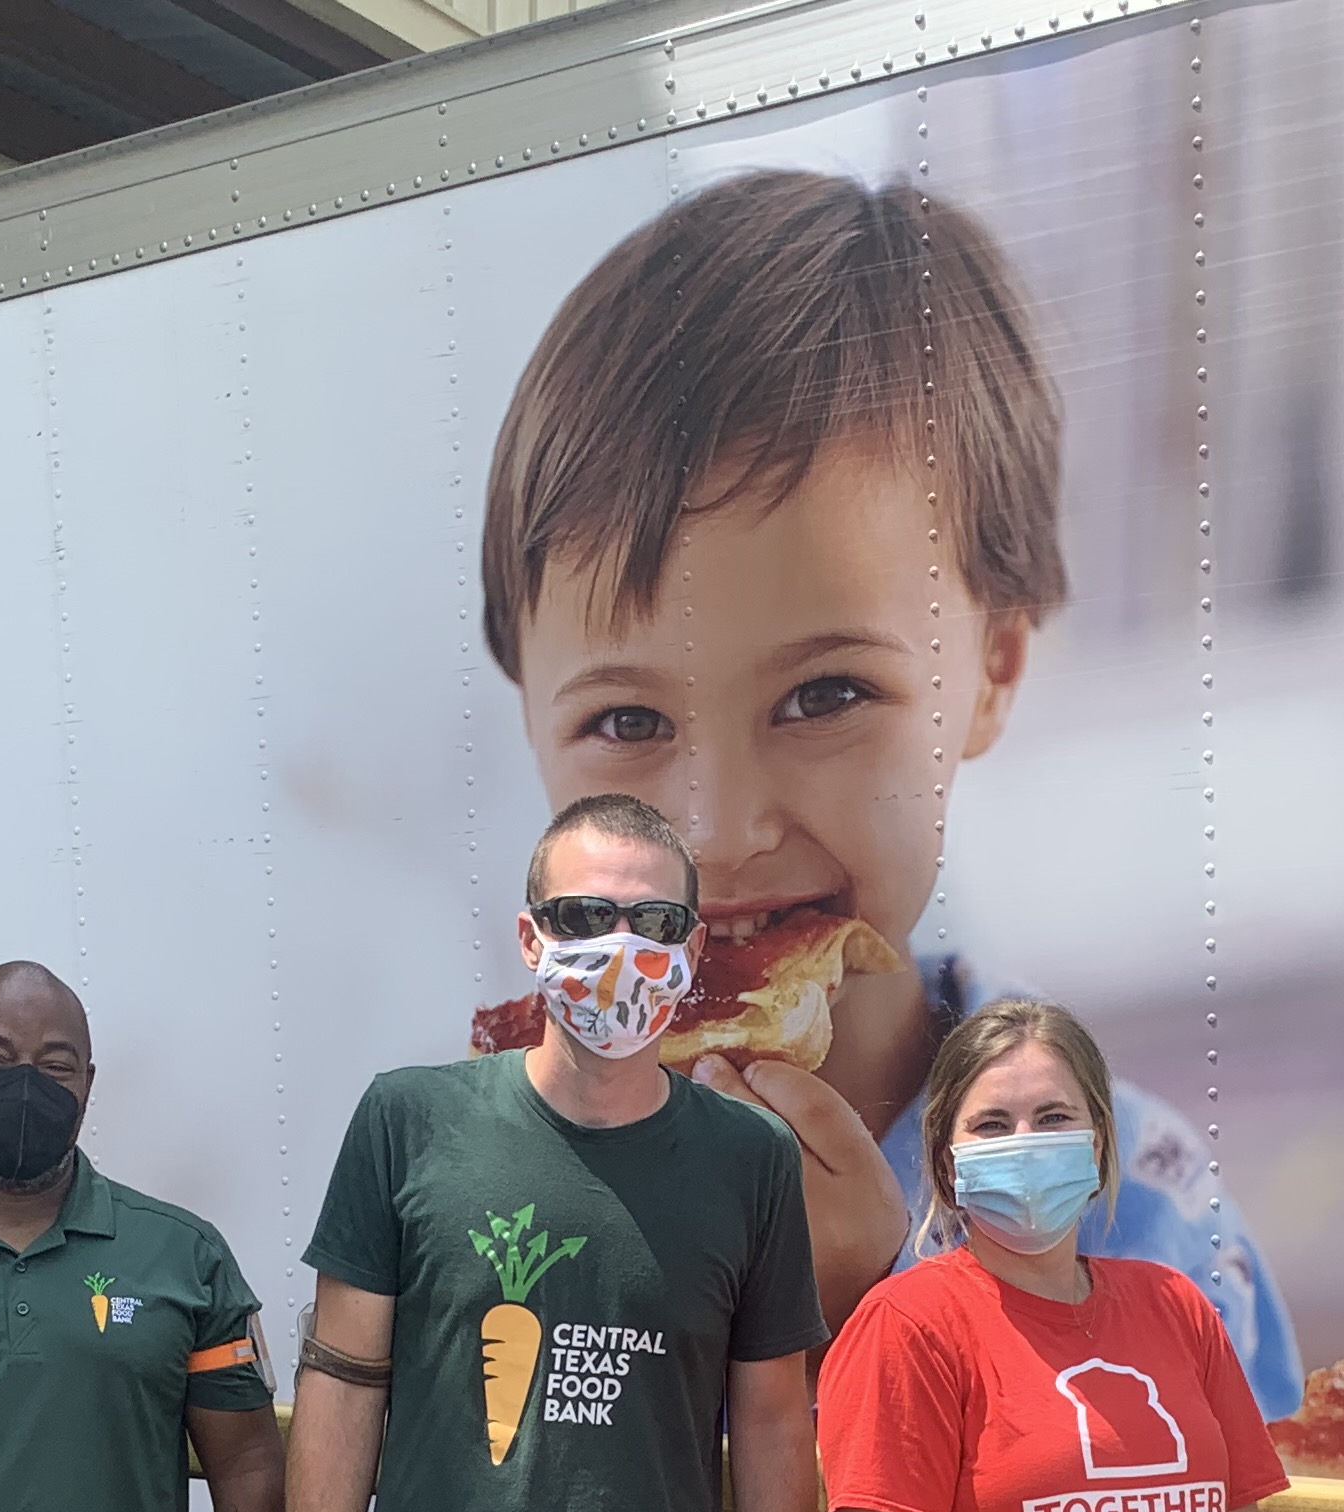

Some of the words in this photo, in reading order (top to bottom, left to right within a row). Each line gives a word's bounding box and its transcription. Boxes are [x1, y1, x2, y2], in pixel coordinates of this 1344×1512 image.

[553, 1323, 667, 1354] CENTRAL
[551, 1348, 631, 1376] TEXAS
[546, 1373, 622, 1401] FOOD
[543, 1398, 613, 1425] BANK
